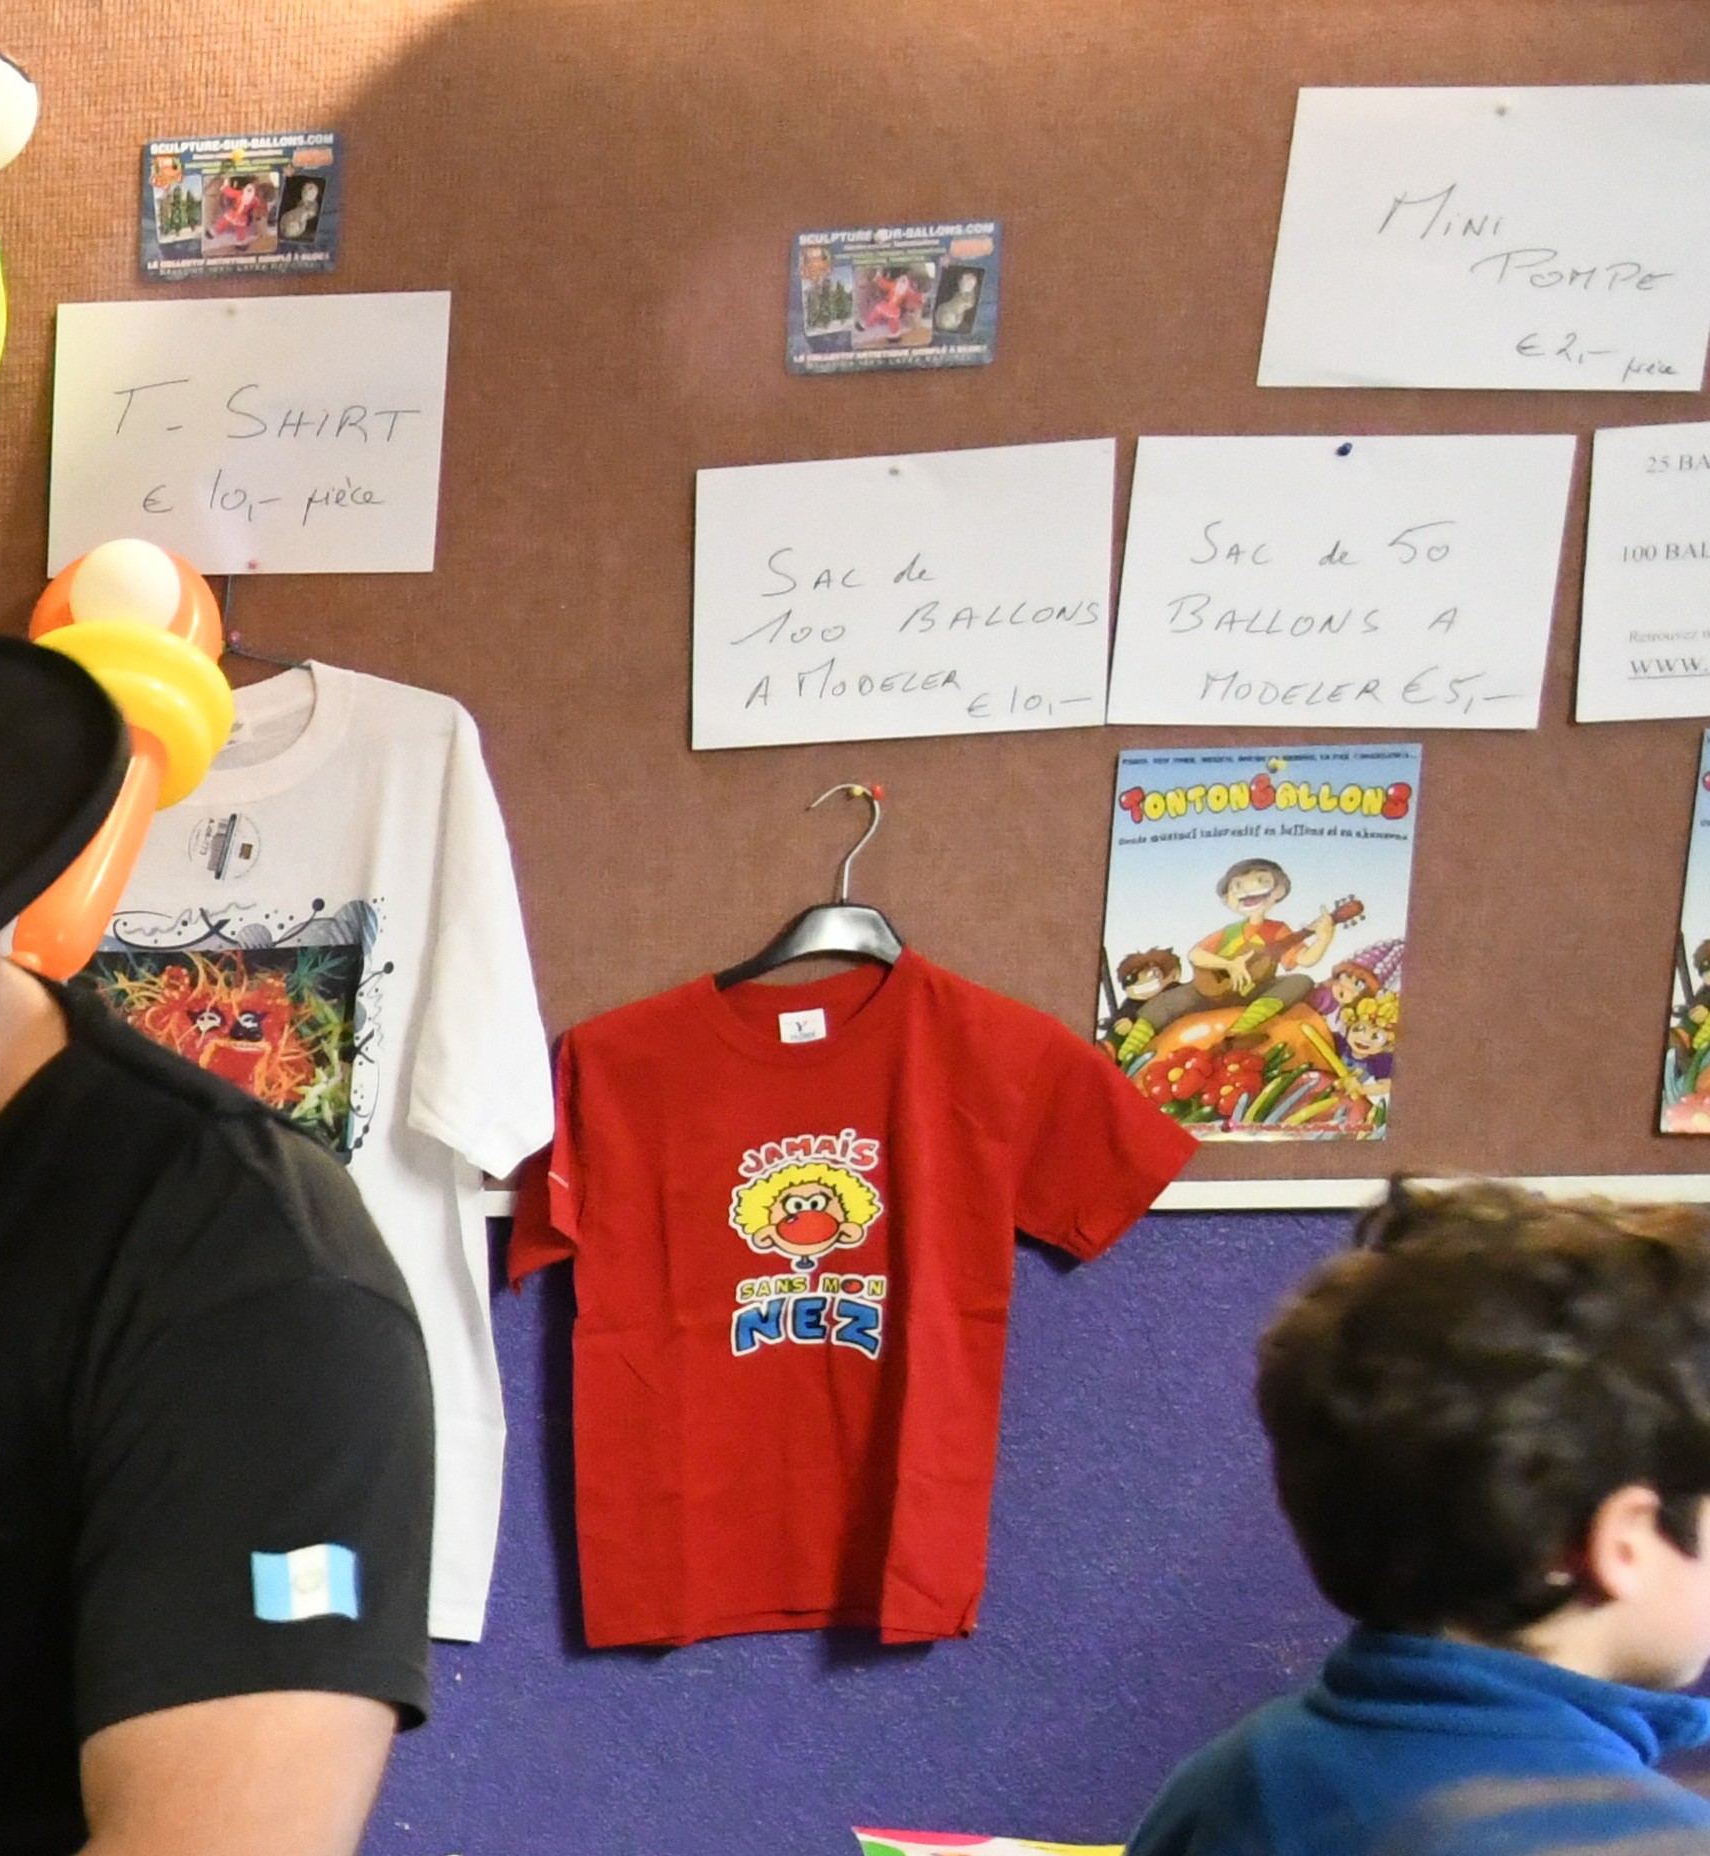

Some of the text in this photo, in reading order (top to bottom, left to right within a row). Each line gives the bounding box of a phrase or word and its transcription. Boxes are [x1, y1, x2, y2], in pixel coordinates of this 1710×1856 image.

[1471, 248, 1673, 290] POMPE
[1646, 456, 1670, 474] 25
[1319, 539, 1357, 566] de
[1388, 520, 1456, 565] 50
[1622, 545, 1657, 563] 100
[893, 553, 937, 585] de
[730, 601, 1101, 645] 100 BALLONS
[1167, 593, 1459, 636] BALLONS A
[798, 657, 961, 699] MODELER
[1200, 671, 1380, 706] MODELER
[741, 1277, 885, 1300] SANS MON
[734, 1299, 881, 1356] NEZ
